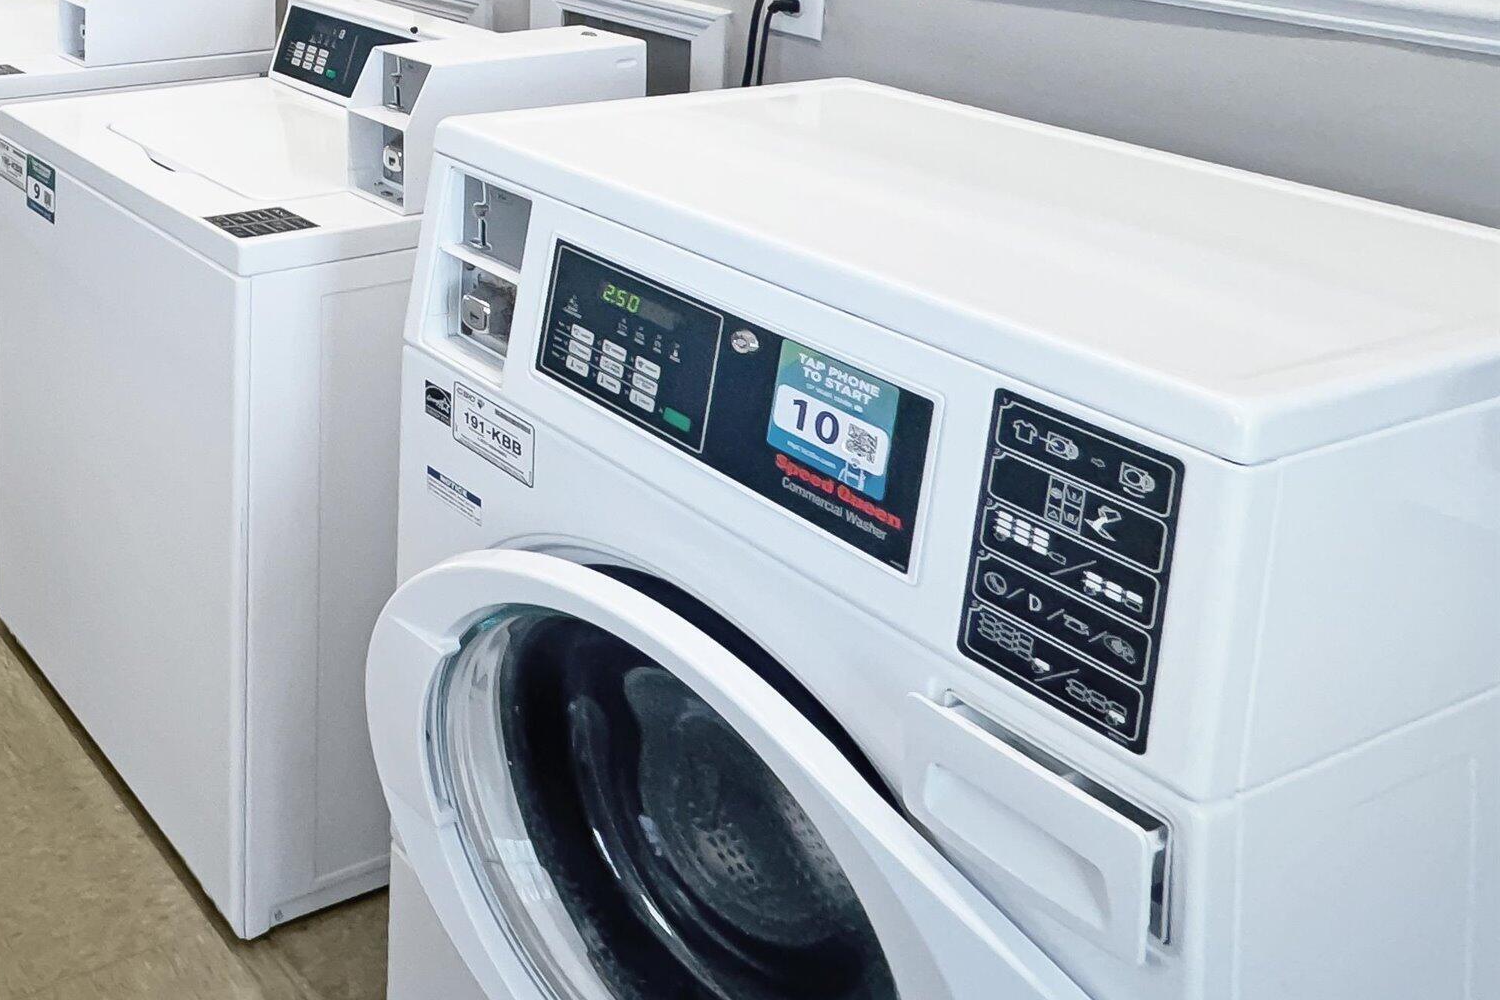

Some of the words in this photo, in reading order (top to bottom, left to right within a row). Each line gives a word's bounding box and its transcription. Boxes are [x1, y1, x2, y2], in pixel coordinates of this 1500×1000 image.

[33, 183, 41, 199] 9
[798, 352, 826, 371] TAP
[828, 366, 880, 398] PHONE
[802, 366, 822, 383] TO
[824, 377, 872, 405] START
[464, 411, 522, 456] 191-KBB
[792, 398, 840, 445] 10
[775, 453, 836, 494] Speed
[837, 483, 903, 530] Queen
[781, 476, 843, 517] Commercial
[845, 506, 888, 541] Washer
